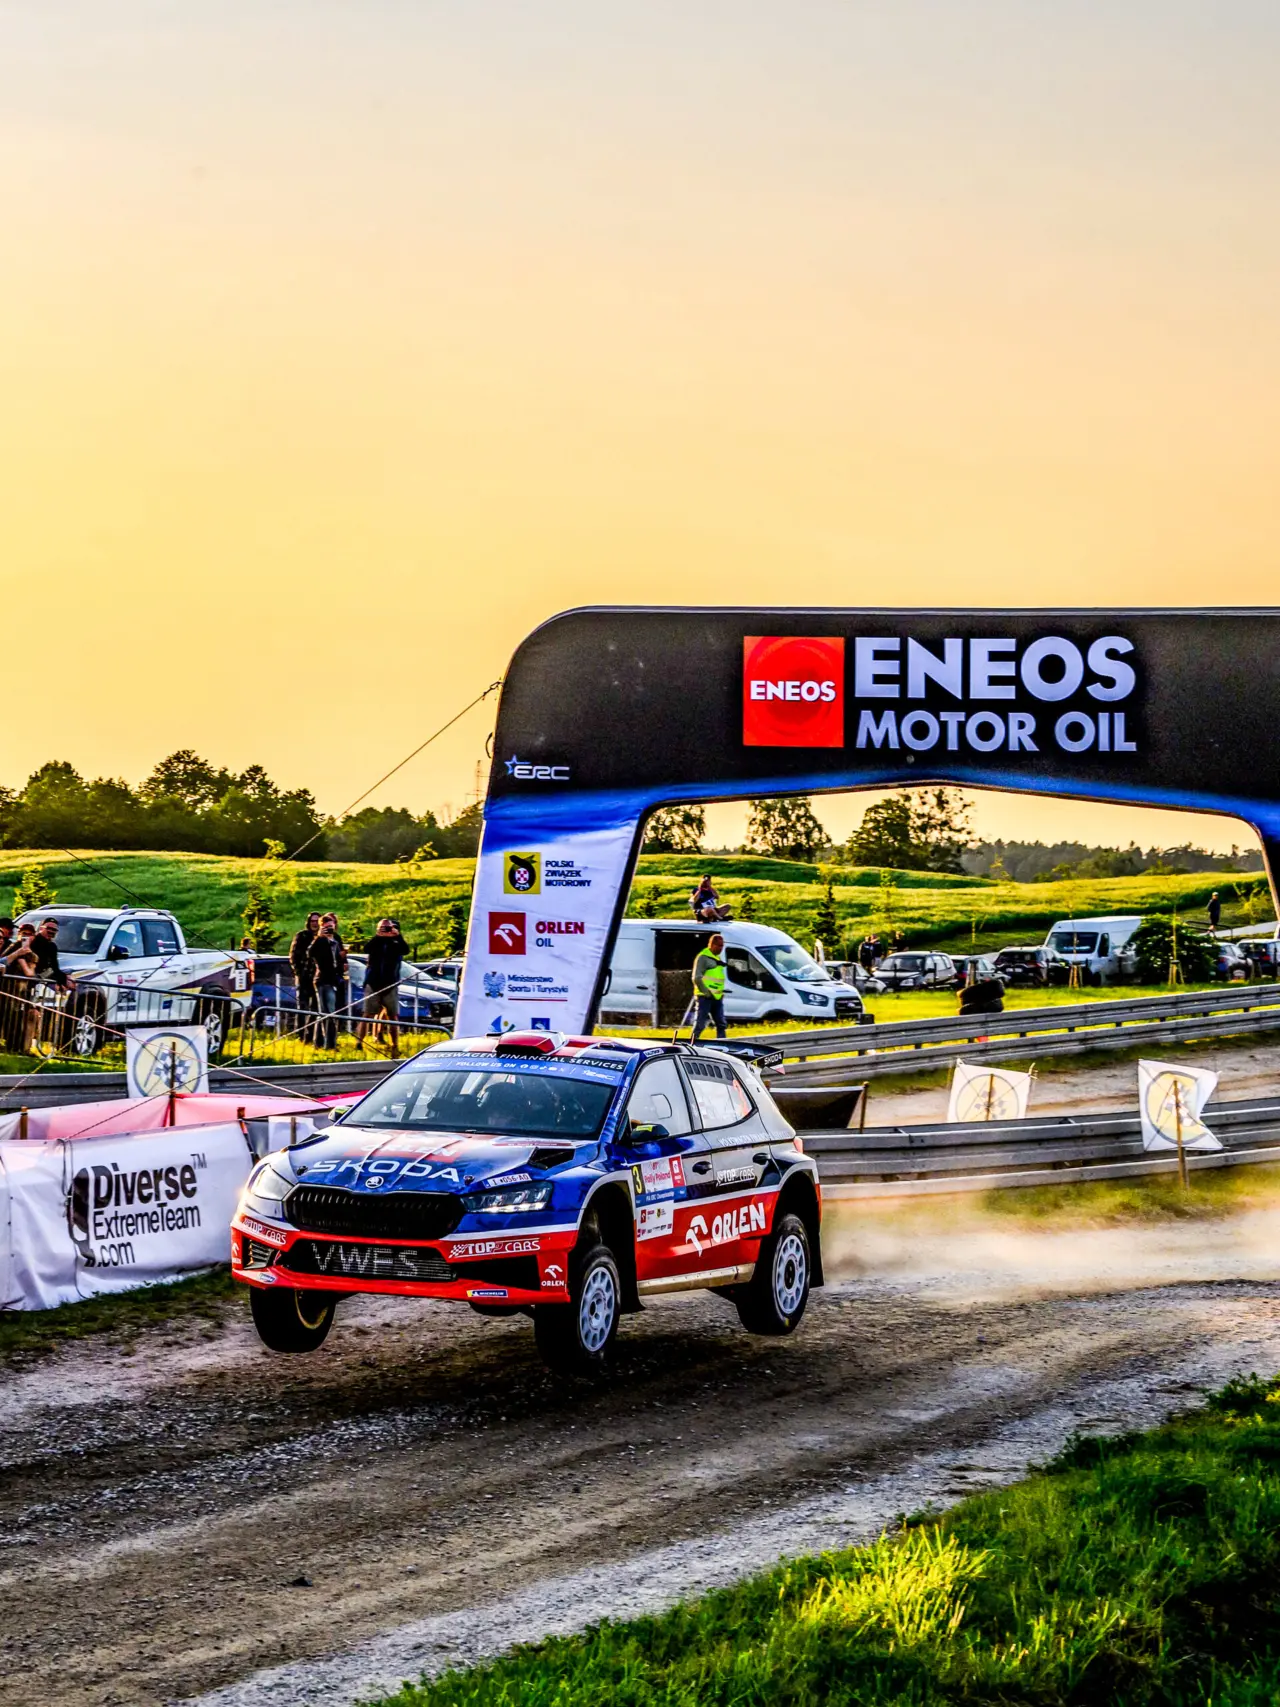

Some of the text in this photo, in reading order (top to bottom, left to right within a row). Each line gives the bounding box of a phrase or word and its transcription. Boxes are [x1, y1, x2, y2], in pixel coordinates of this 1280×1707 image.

[855, 636, 1136, 702] ENEOS
[750, 680, 835, 702] ENEOS
[856, 709, 1137, 752] MOTOR OIL
[514, 765, 570, 780] ERC
[545, 860, 574, 868] POLSKI
[545, 870, 582, 878] ZWIĄZEK
[545, 879, 592, 887] MOTOROWY
[535, 921, 585, 935] ORLEN
[535, 937, 554, 948] OIL
[508, 975, 554, 983] Ministerstwo
[508, 984, 531, 993] Sportu
[537, 985, 569, 994] Turystyki
[499, 1053, 566, 1064] FINANCIAL
[569, 1057, 625, 1071] SERVICES
[307, 1159, 460, 1183] SKODA
[632, 1165, 642, 1194] 3
[91, 1163, 198, 1209] Diverse
[93, 1202, 201, 1241] ExtremeTeam
[711, 1202, 766, 1243] ORLEN
[97, 1241, 136, 1268] .com
[468, 1240, 541, 1255] TOP CARS
[311, 1242, 419, 1278] VWFS
